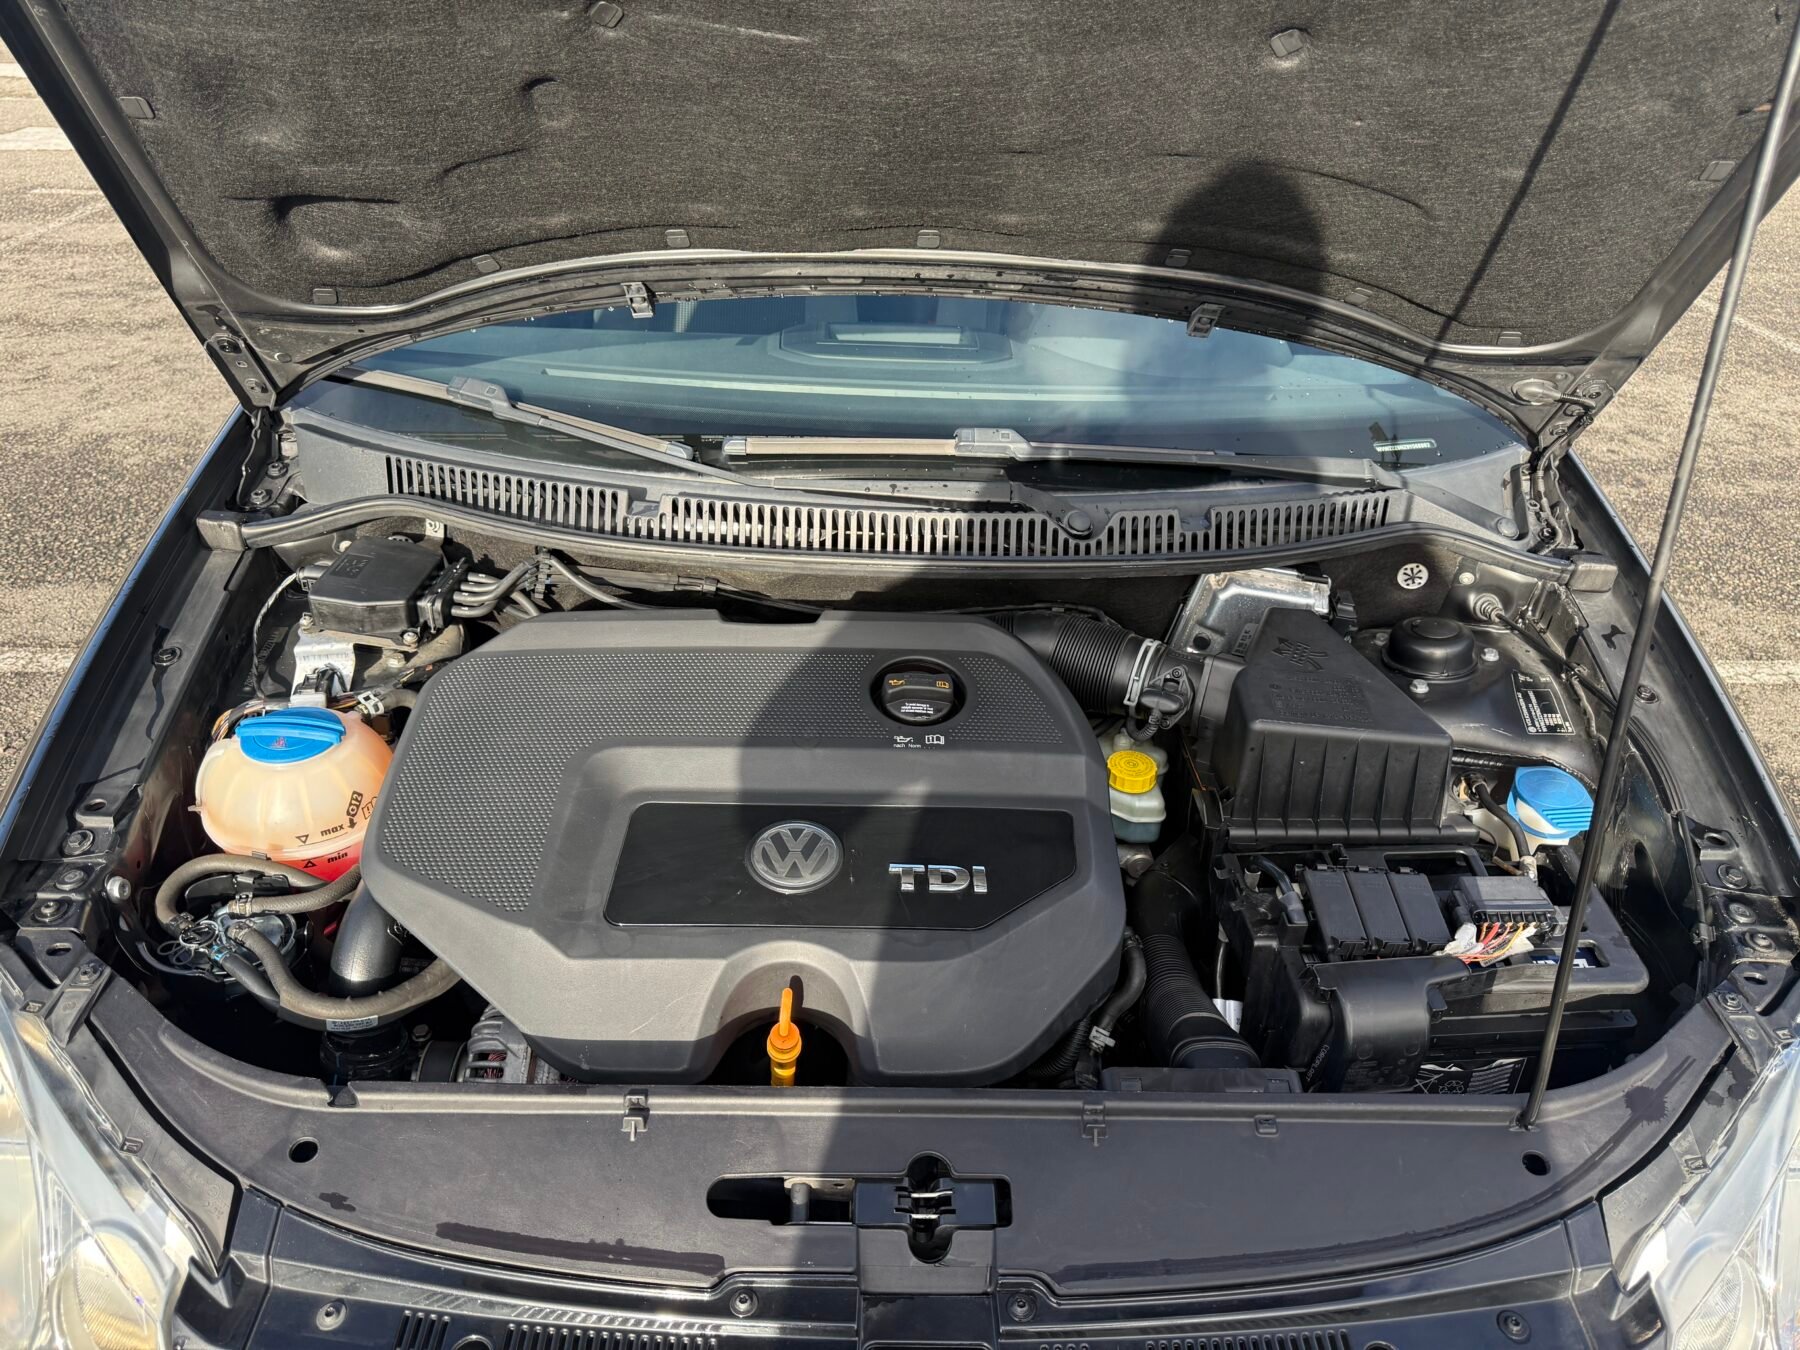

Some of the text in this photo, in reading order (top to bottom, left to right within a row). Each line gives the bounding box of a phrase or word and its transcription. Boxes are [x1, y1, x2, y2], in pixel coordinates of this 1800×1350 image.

[320, 824, 345, 837] max
[327, 852, 349, 863] min
[751, 823, 840, 887] VW
[888, 863, 988, 893] TDI
